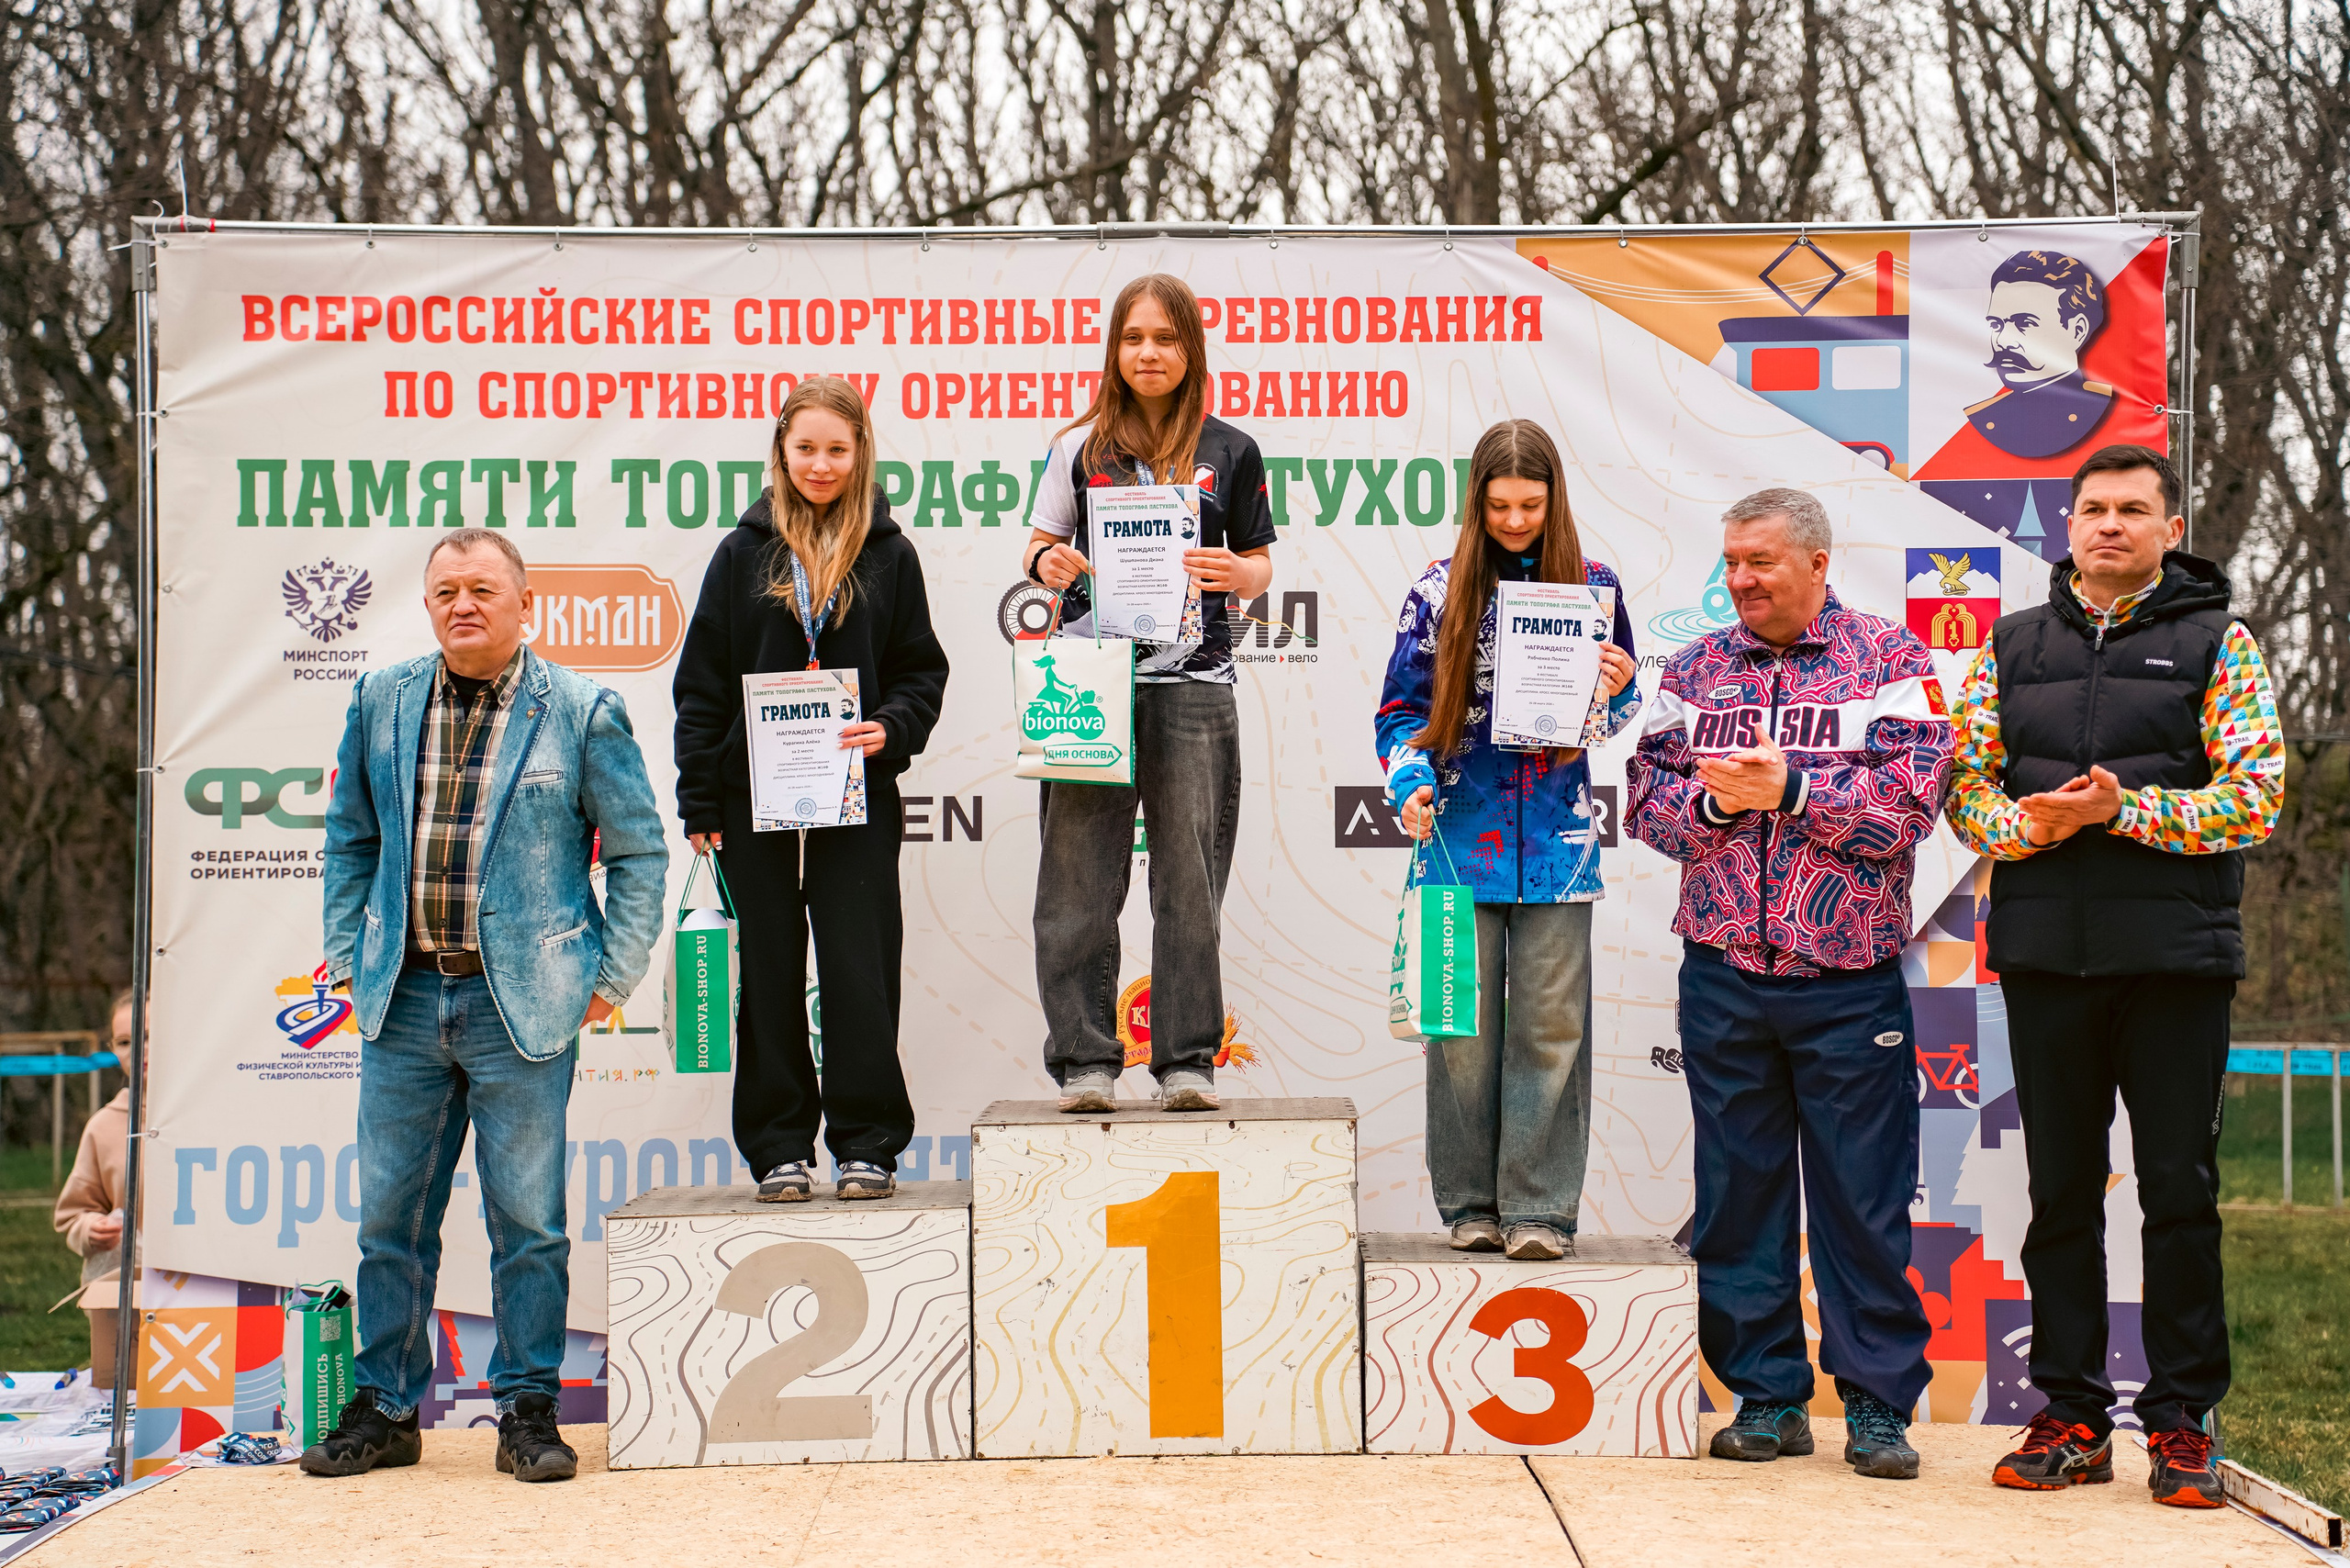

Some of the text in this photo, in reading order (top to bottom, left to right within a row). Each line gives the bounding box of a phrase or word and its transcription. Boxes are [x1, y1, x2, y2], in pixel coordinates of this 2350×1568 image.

[241, 287, 1544, 346] ВСЕРОССИЙСКИЕ СПОРТИВНЫЕ РЕВНОВАНИЯ
[384, 370, 1408, 420] ПО СПОРТИВНОУ ОРИЕНТВАНИЮ
[236, 458, 577, 529] ПАМЯТИ
[611, 458, 1046, 530] ТОПРАФ
[1103, 519, 1172, 538] ГРАМОТА
[520, 595, 661, 646] УКМАН
[1512, 616, 1583, 637] ГРАМОТА
[283, 650, 369, 662] МИНСПОРТ
[1288, 654, 1318, 663] вело
[2145, 658, 2174, 667] STROBBS
[293, 668, 357, 680] РОССИИ
[1714, 687, 1735, 698] BOSCO
[760, 702, 831, 722] ГРАМОТА
[1024, 711, 1104, 731] bionova
[776, 728, 825, 736] НАГРАЖДАЕТСЯ
[1071, 749, 1114, 759] ОСНОВА
[190, 849, 308, 864] ФЕДЕРАЦИЯ
[1442, 890, 1455, 1033] BIONOVA-SHOP.RU
[697, 935, 709, 1069] BIONOVA-SHOP.RU
[281, 1050, 359, 1059] МИНИСТЕРСТВО
[237, 1061, 304, 1071] ФИЗИЧЕСКОЙ
[306, 1061, 353, 1070] КУЛЬТУРЫ
[259, 1071, 354, 1081] СТАВРОПОЛЬСКОГО
[1105, 1170, 1224, 1439] 1
[707, 1240, 873, 1443] 2
[1467, 1286, 1595, 1445] 3
[335, 1352, 346, 1406] BIONOVA
[317, 1353, 330, 1443] ОДПИШИСЬ
